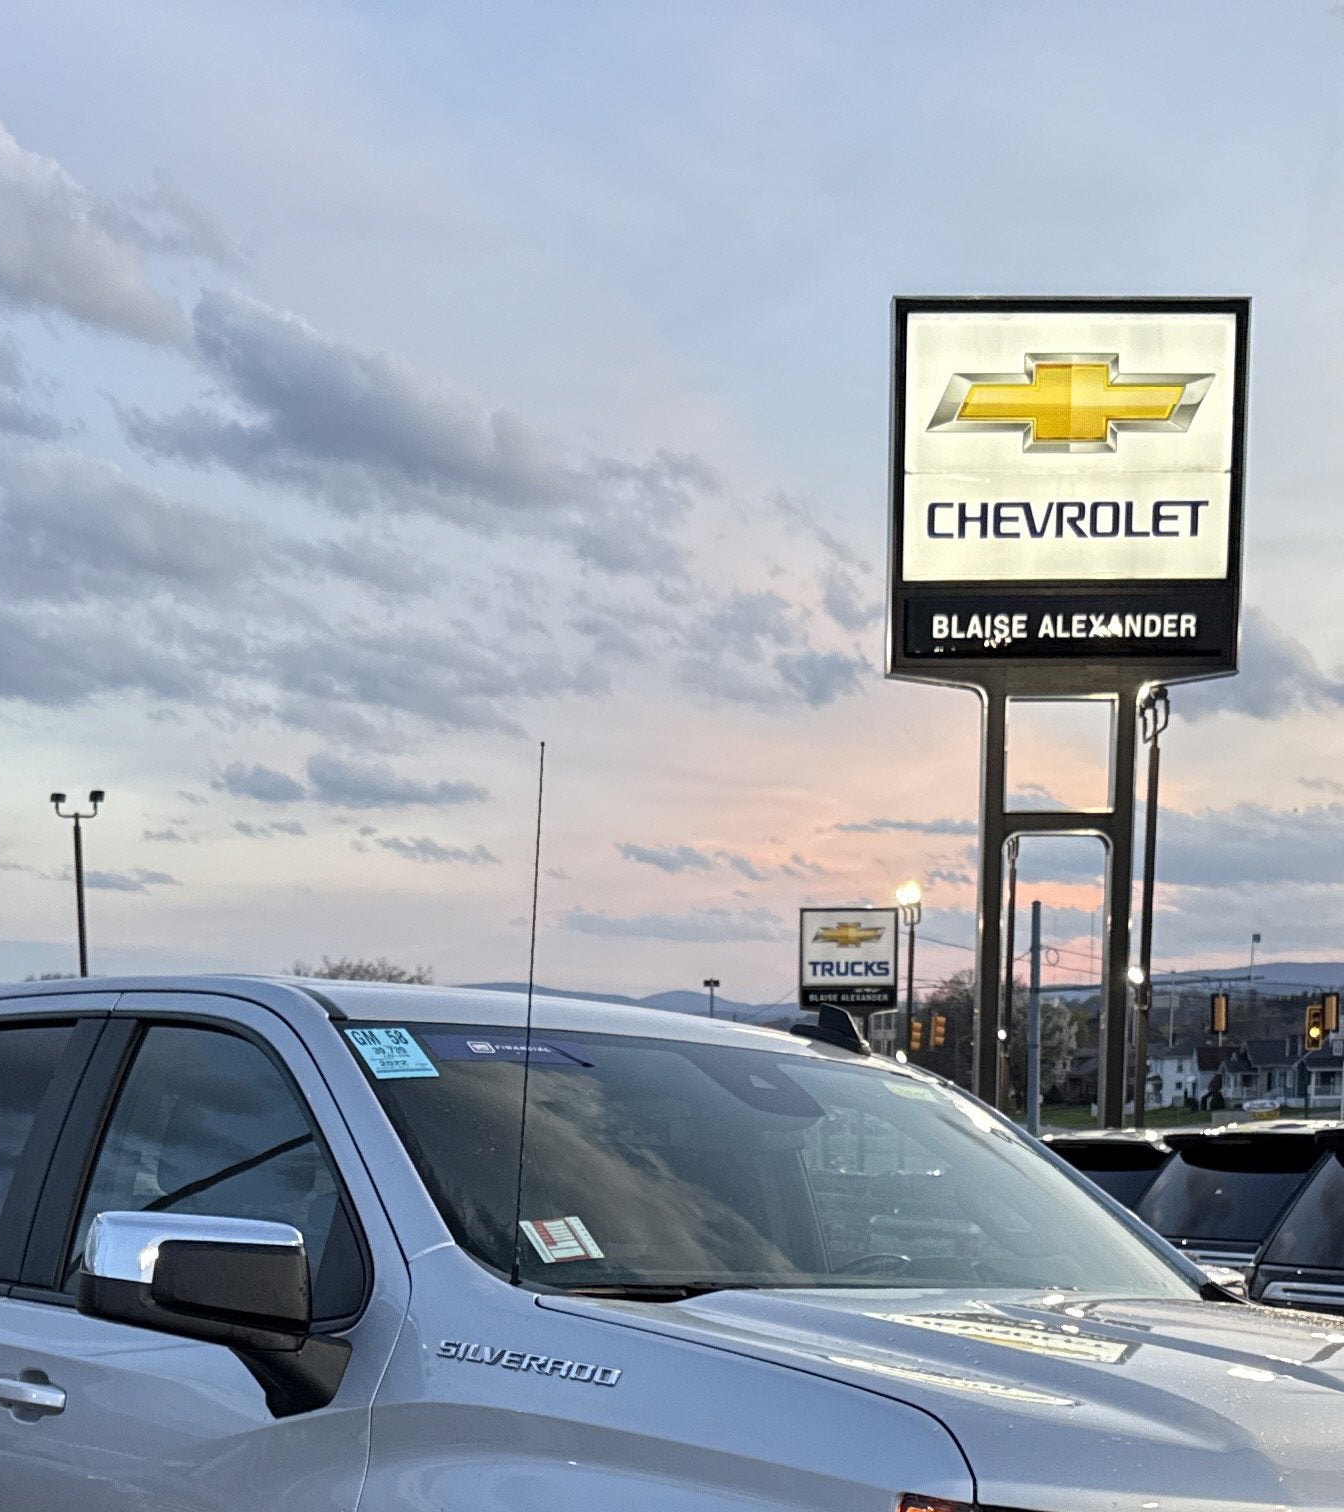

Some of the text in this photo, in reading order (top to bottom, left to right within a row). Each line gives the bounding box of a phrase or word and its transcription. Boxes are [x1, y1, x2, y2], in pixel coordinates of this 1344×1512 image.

[927, 499, 1209, 539] CHEVROLET
[932, 612, 1197, 640] BLAISE ALEXANDER
[808, 961, 890, 977] TRUCKS
[809, 993, 888, 1002] BLAISE ALEXANDER
[351, 1030, 382, 1046] GM
[436, 1339, 623, 1388] SILVERADO
